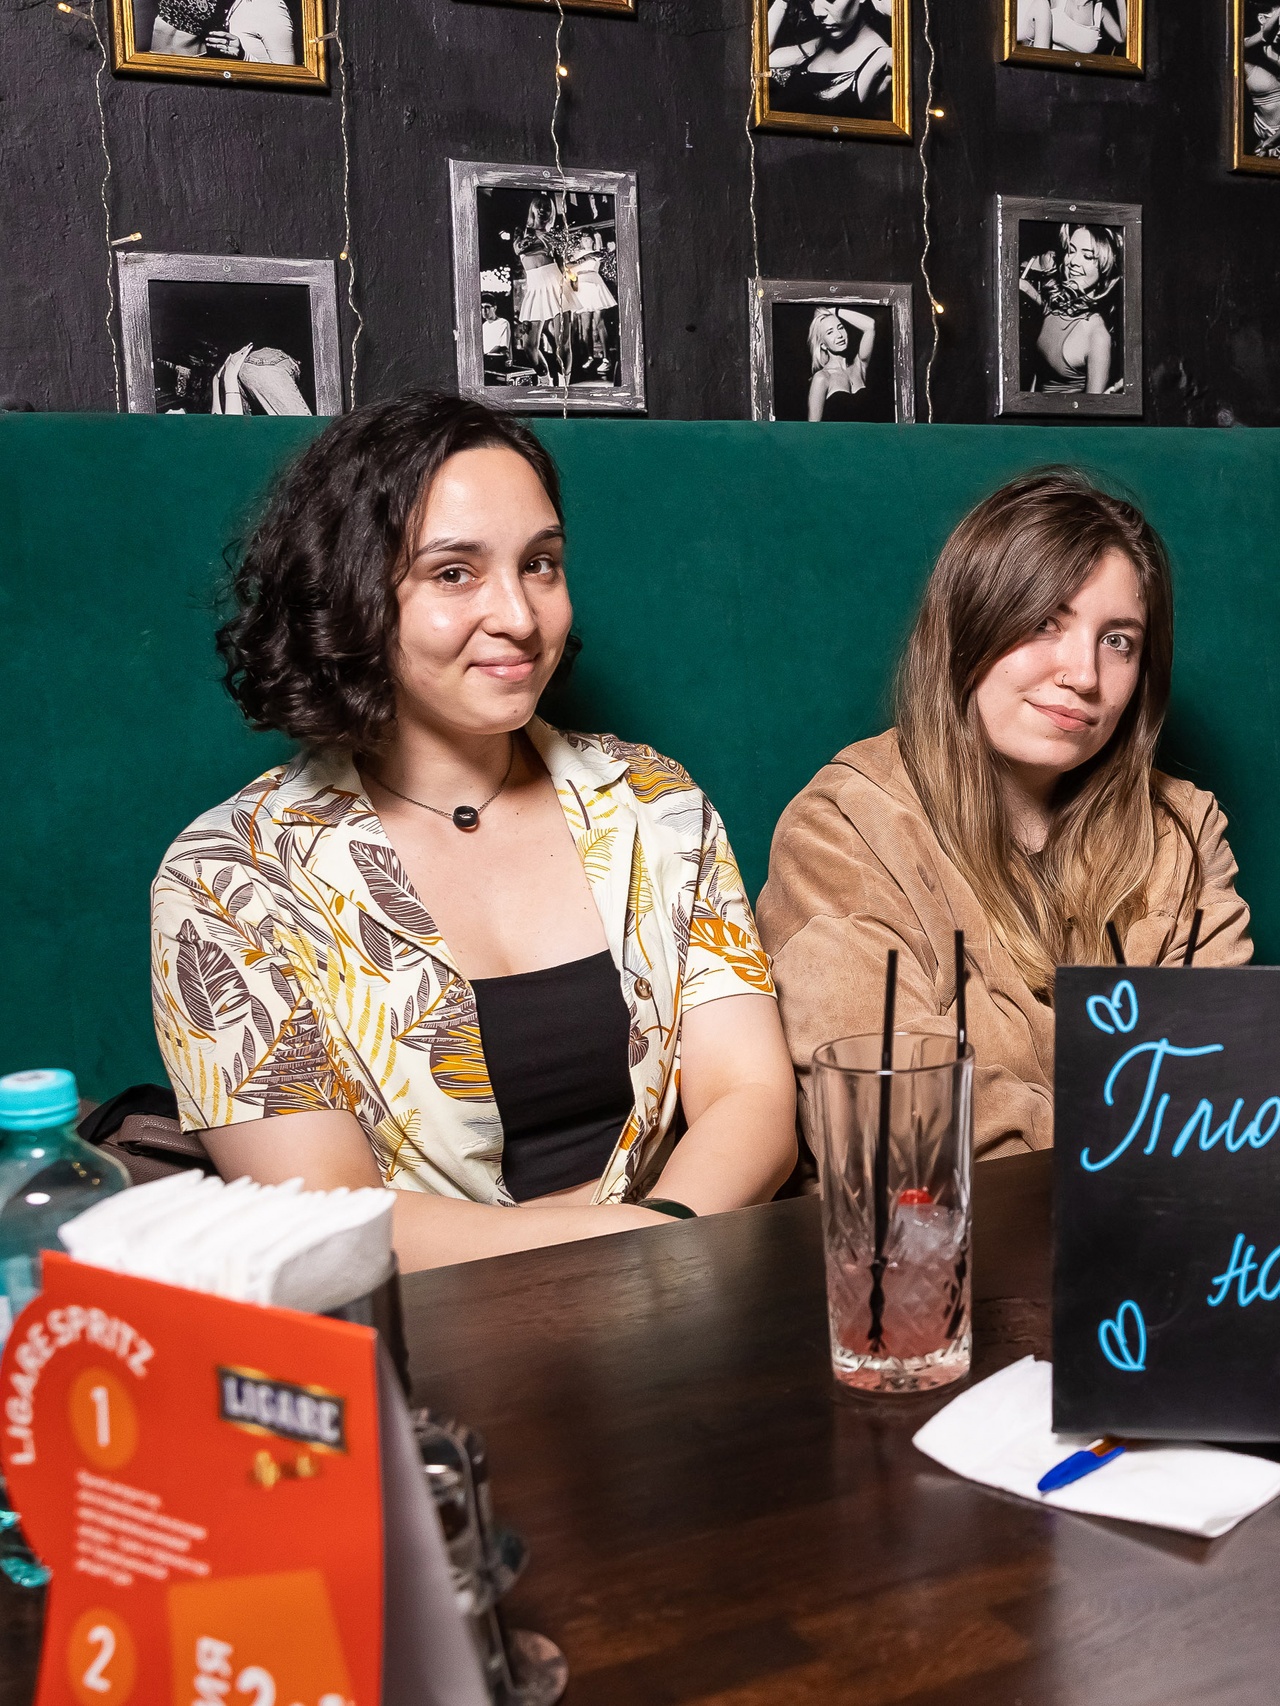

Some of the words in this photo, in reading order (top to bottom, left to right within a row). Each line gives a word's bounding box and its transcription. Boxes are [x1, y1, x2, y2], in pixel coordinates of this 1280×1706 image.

[4, 1322, 57, 1466] LIGARE
[46, 1304, 156, 1380] SPRITZ
[90, 1385, 112, 1448] 1
[82, 1624, 117, 1693] 2
